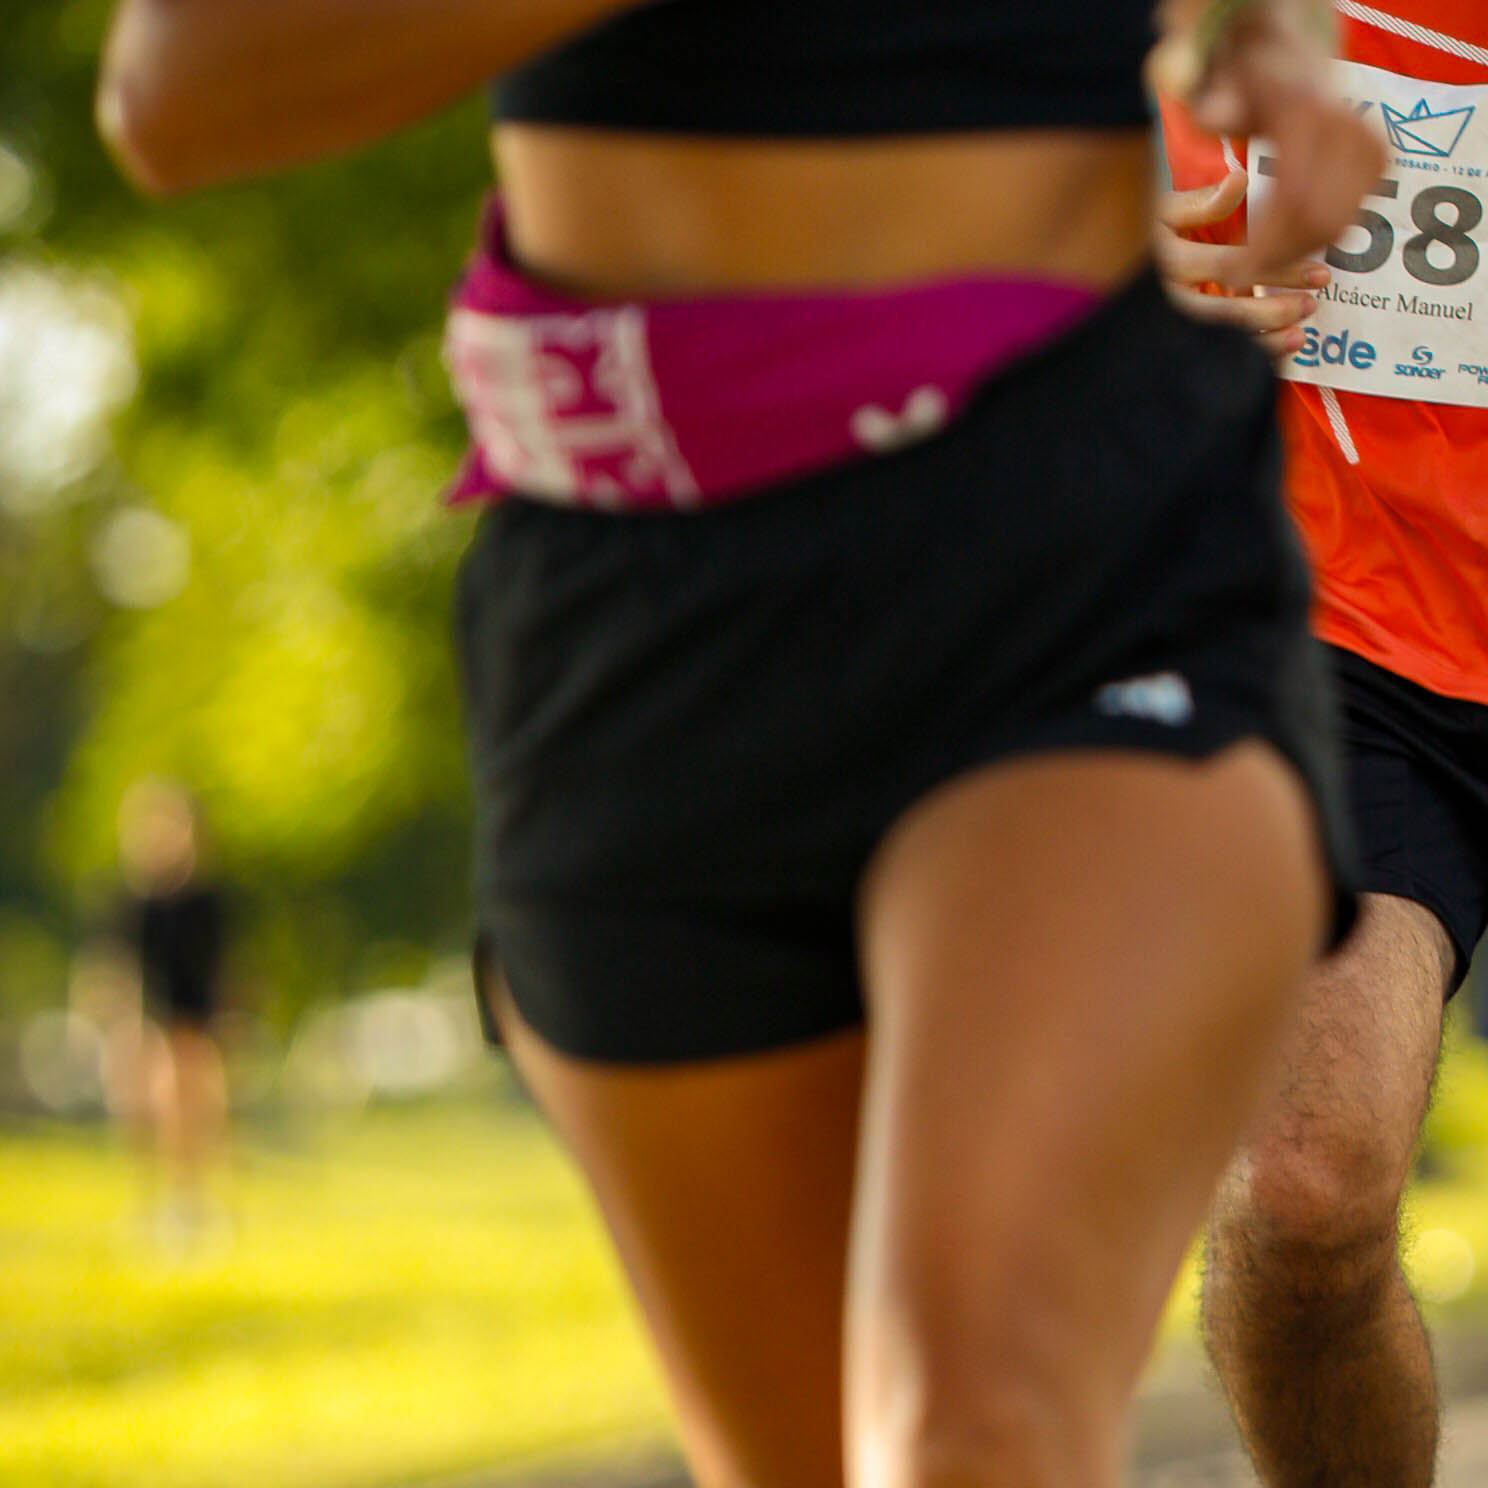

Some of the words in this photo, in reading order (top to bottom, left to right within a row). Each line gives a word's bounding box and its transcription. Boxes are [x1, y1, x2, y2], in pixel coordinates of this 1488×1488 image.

[1452, 164, 1465, 176] 12
[1316, 282, 1391, 311] Alcácer
[1397, 292, 1474, 321] Manuel
[1293, 326, 1377, 370] sde
